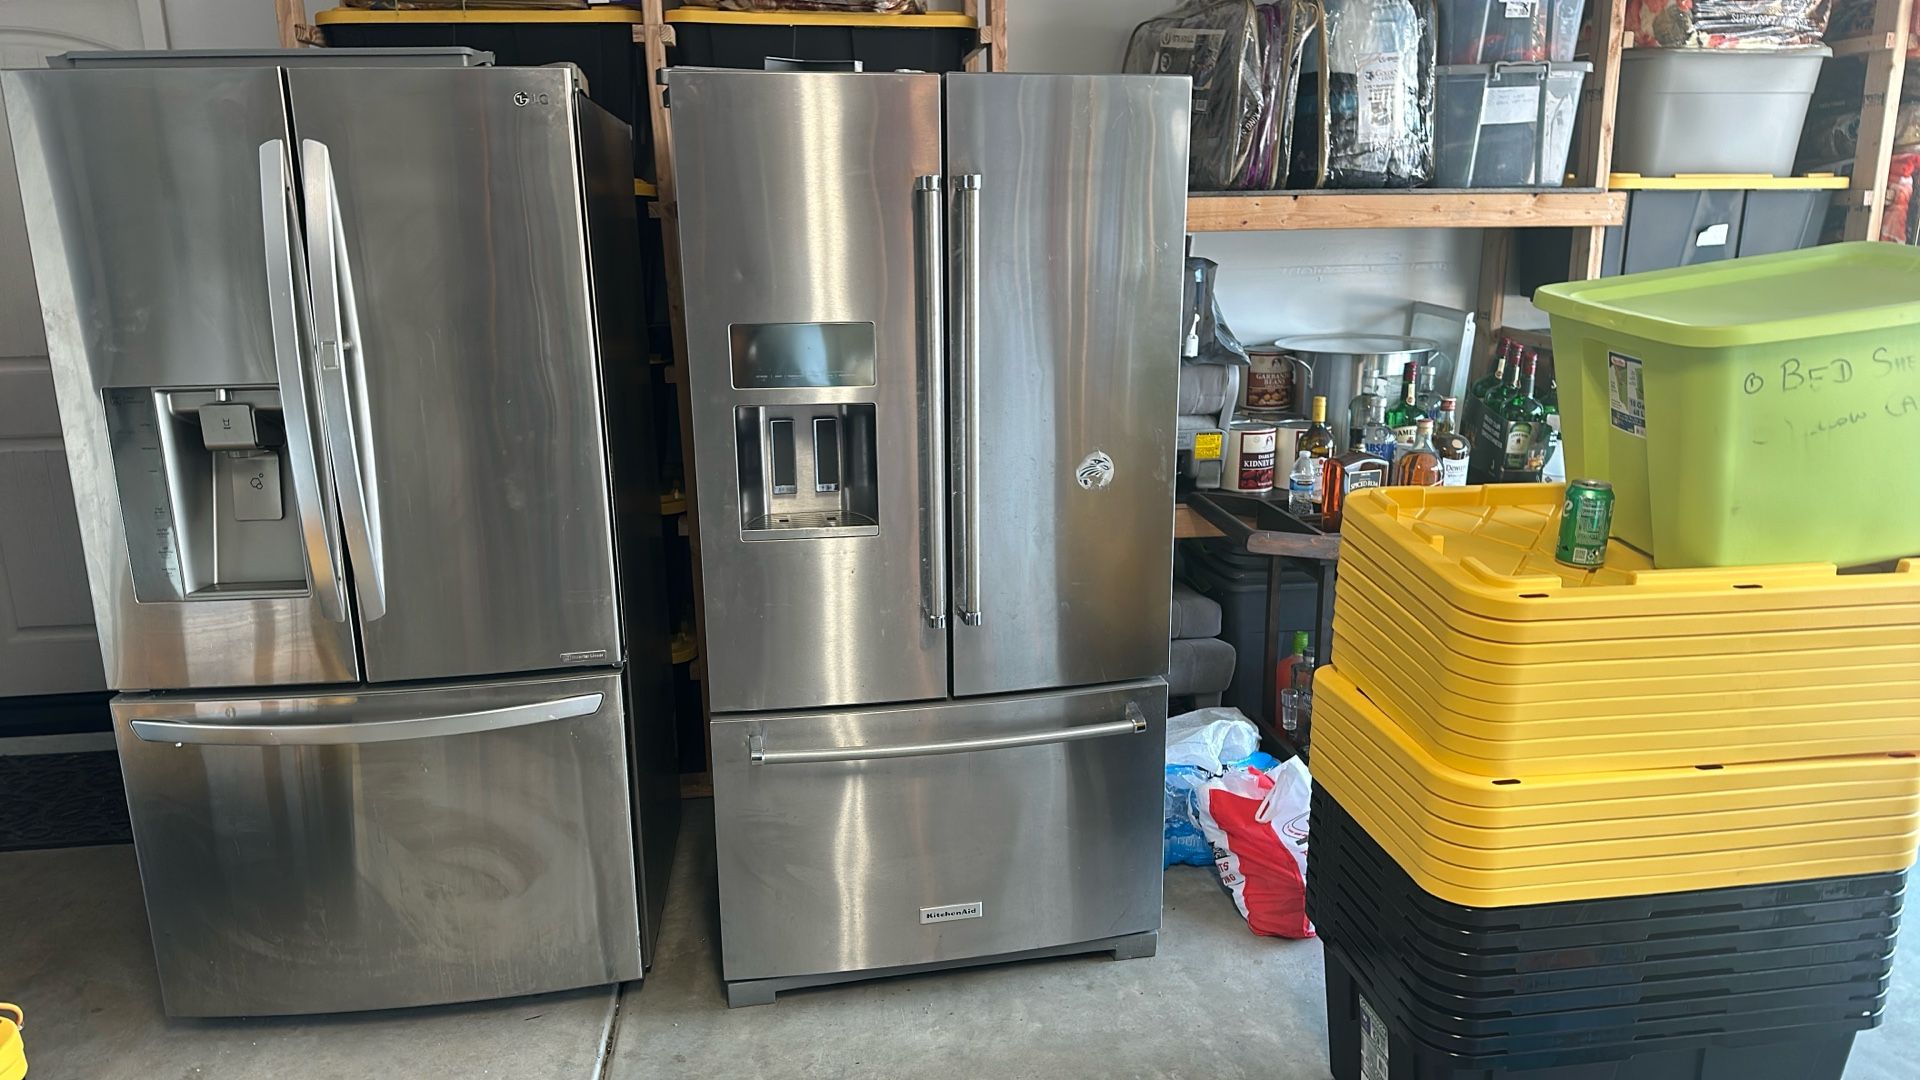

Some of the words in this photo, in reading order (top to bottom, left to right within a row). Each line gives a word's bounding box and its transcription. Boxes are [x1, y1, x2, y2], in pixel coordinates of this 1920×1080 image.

[1780, 358, 1853, 392] BED
[1872, 347, 1917, 377] SHE
[1885, 395, 1918, 417] CA
[1243, 459, 1270, 467] KIDNEY
[1350, 481, 1367, 490] SPICED
[1218, 862, 1229, 872] TS
[1223, 874, 1236, 885] ING
[926, 908, 976, 918] KitchenAid
